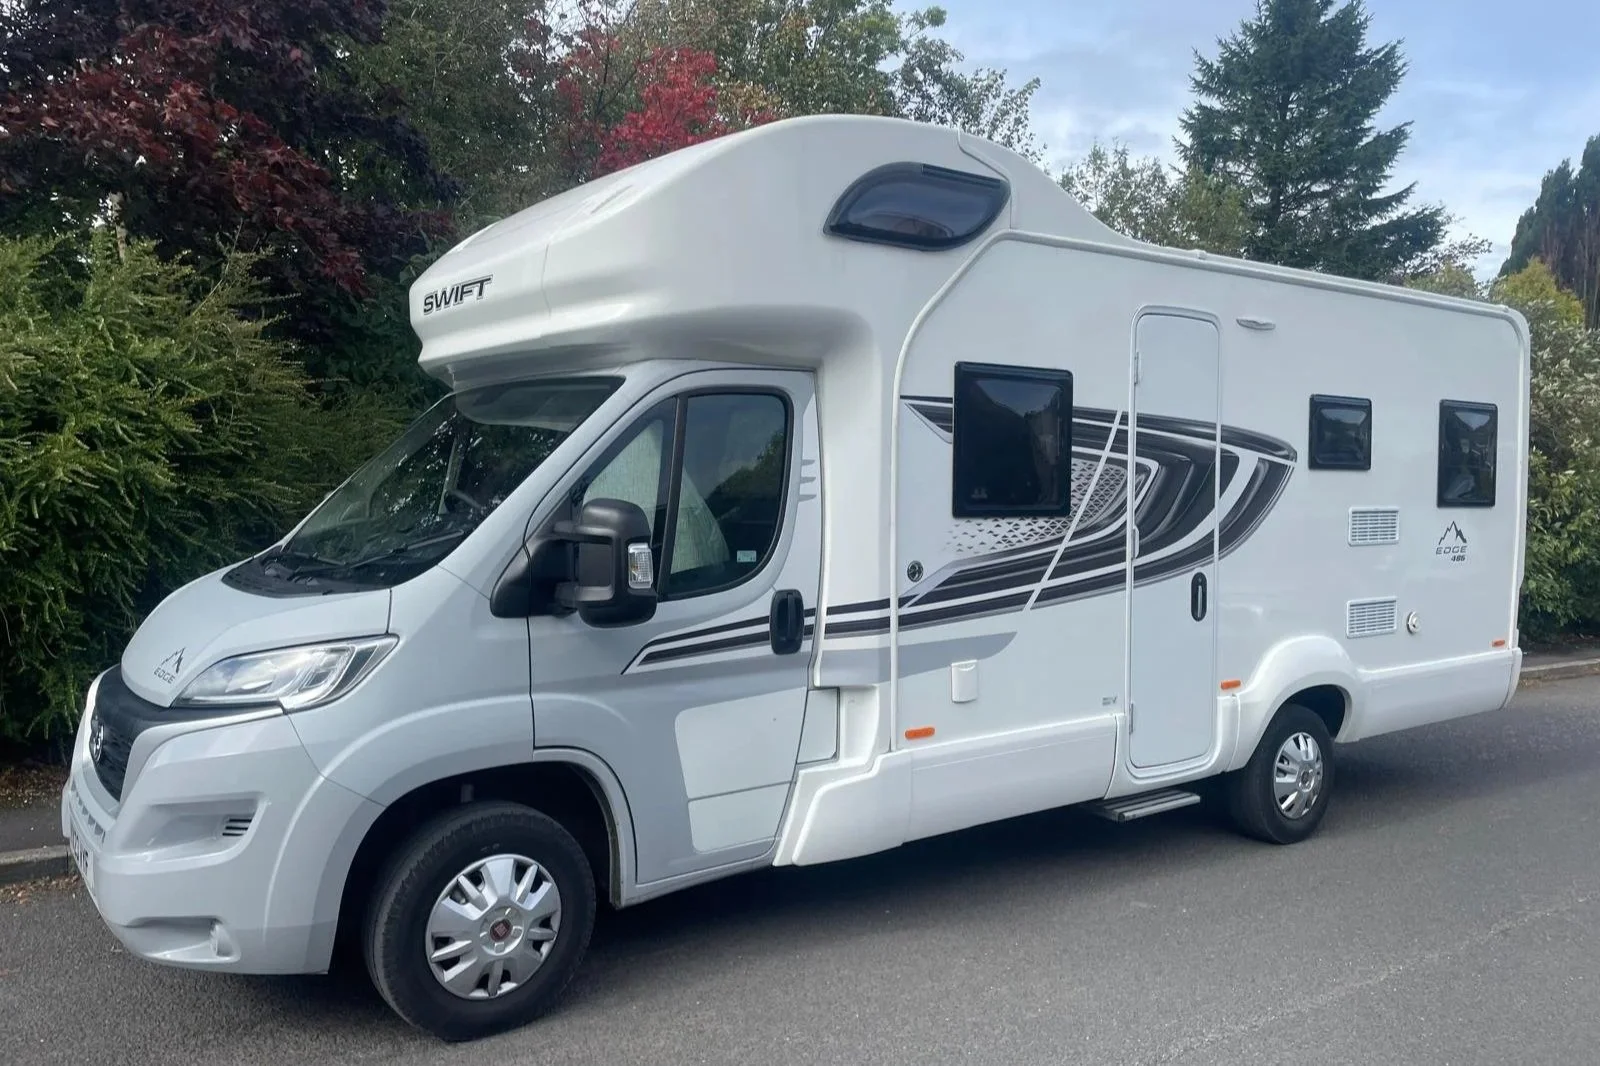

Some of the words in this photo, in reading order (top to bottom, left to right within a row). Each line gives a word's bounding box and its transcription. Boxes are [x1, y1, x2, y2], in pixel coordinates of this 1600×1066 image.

[423, 274, 493, 315] SWIFT
[1436, 545, 1467, 555] EDGE
[153, 667, 176, 684] EDGE
